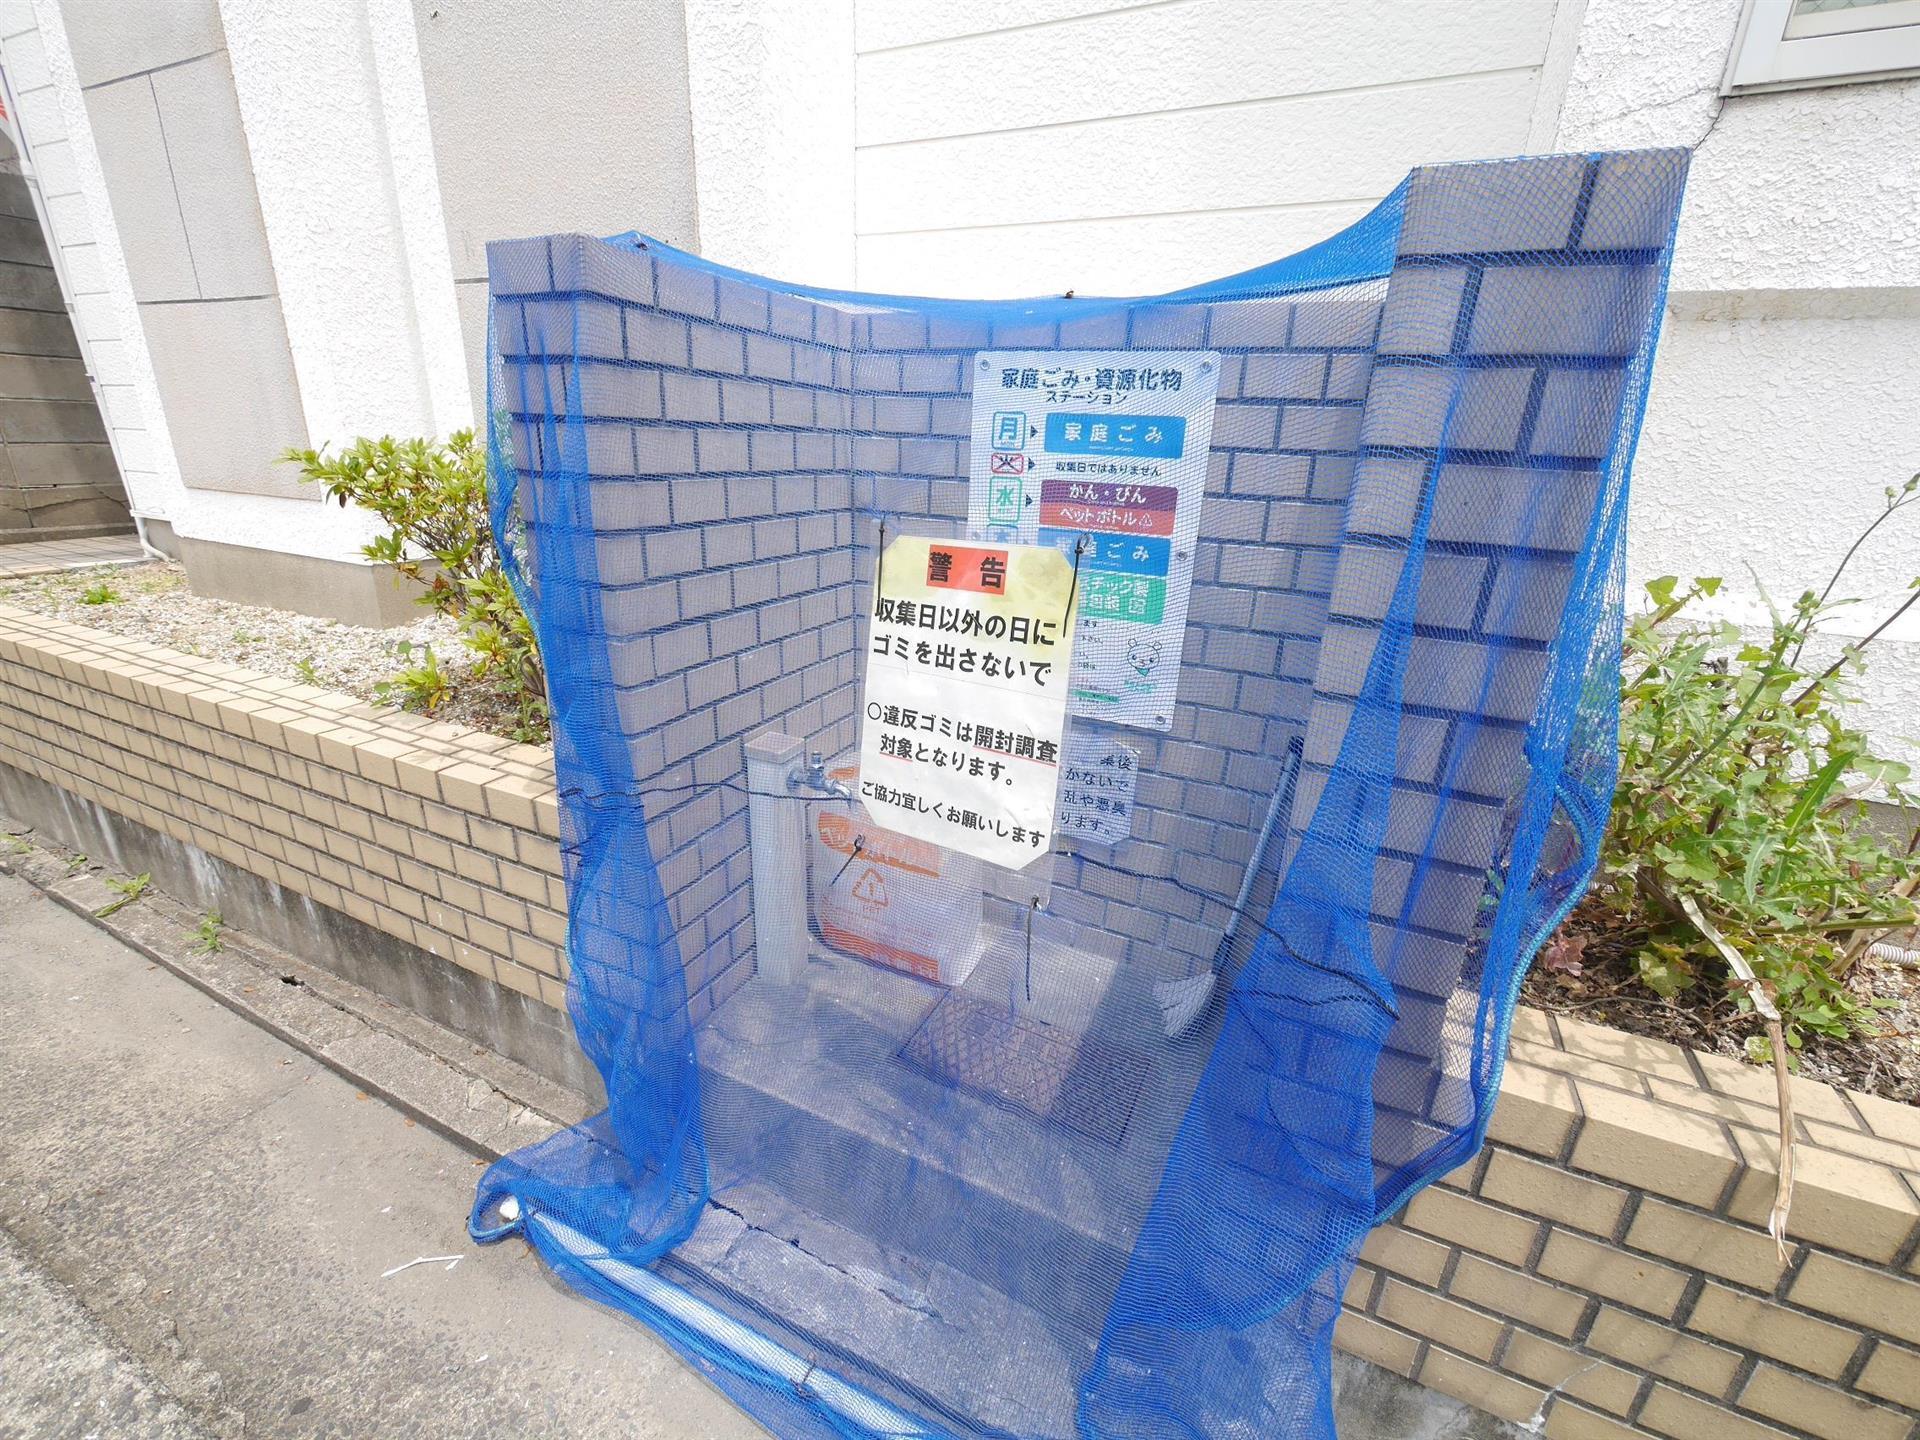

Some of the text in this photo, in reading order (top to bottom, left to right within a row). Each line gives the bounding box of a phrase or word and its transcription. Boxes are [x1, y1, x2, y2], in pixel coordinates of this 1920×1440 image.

[1001, 367, 1182, 391] 家庭ごみ・資源化物
[1046, 390, 1128, 405] ステーション
[999, 417, 1018, 440] 月
[1064, 422, 1163, 444] 家庭ごみ
[1055, 461, 1161, 476] 収集日ではありません
[996, 486, 1014, 507] 水
[1069, 483, 1147, 504] かん・びん
[1060, 507, 1137, 526] ペットボトル
[874, 597, 1057, 646] 収集日以外の日に
[873, 633, 1052, 687] ゴミを出さないで
[879, 733, 1014, 787] 対象となります。
[861, 781, 1046, 848] ご協力宜しくお願いします
